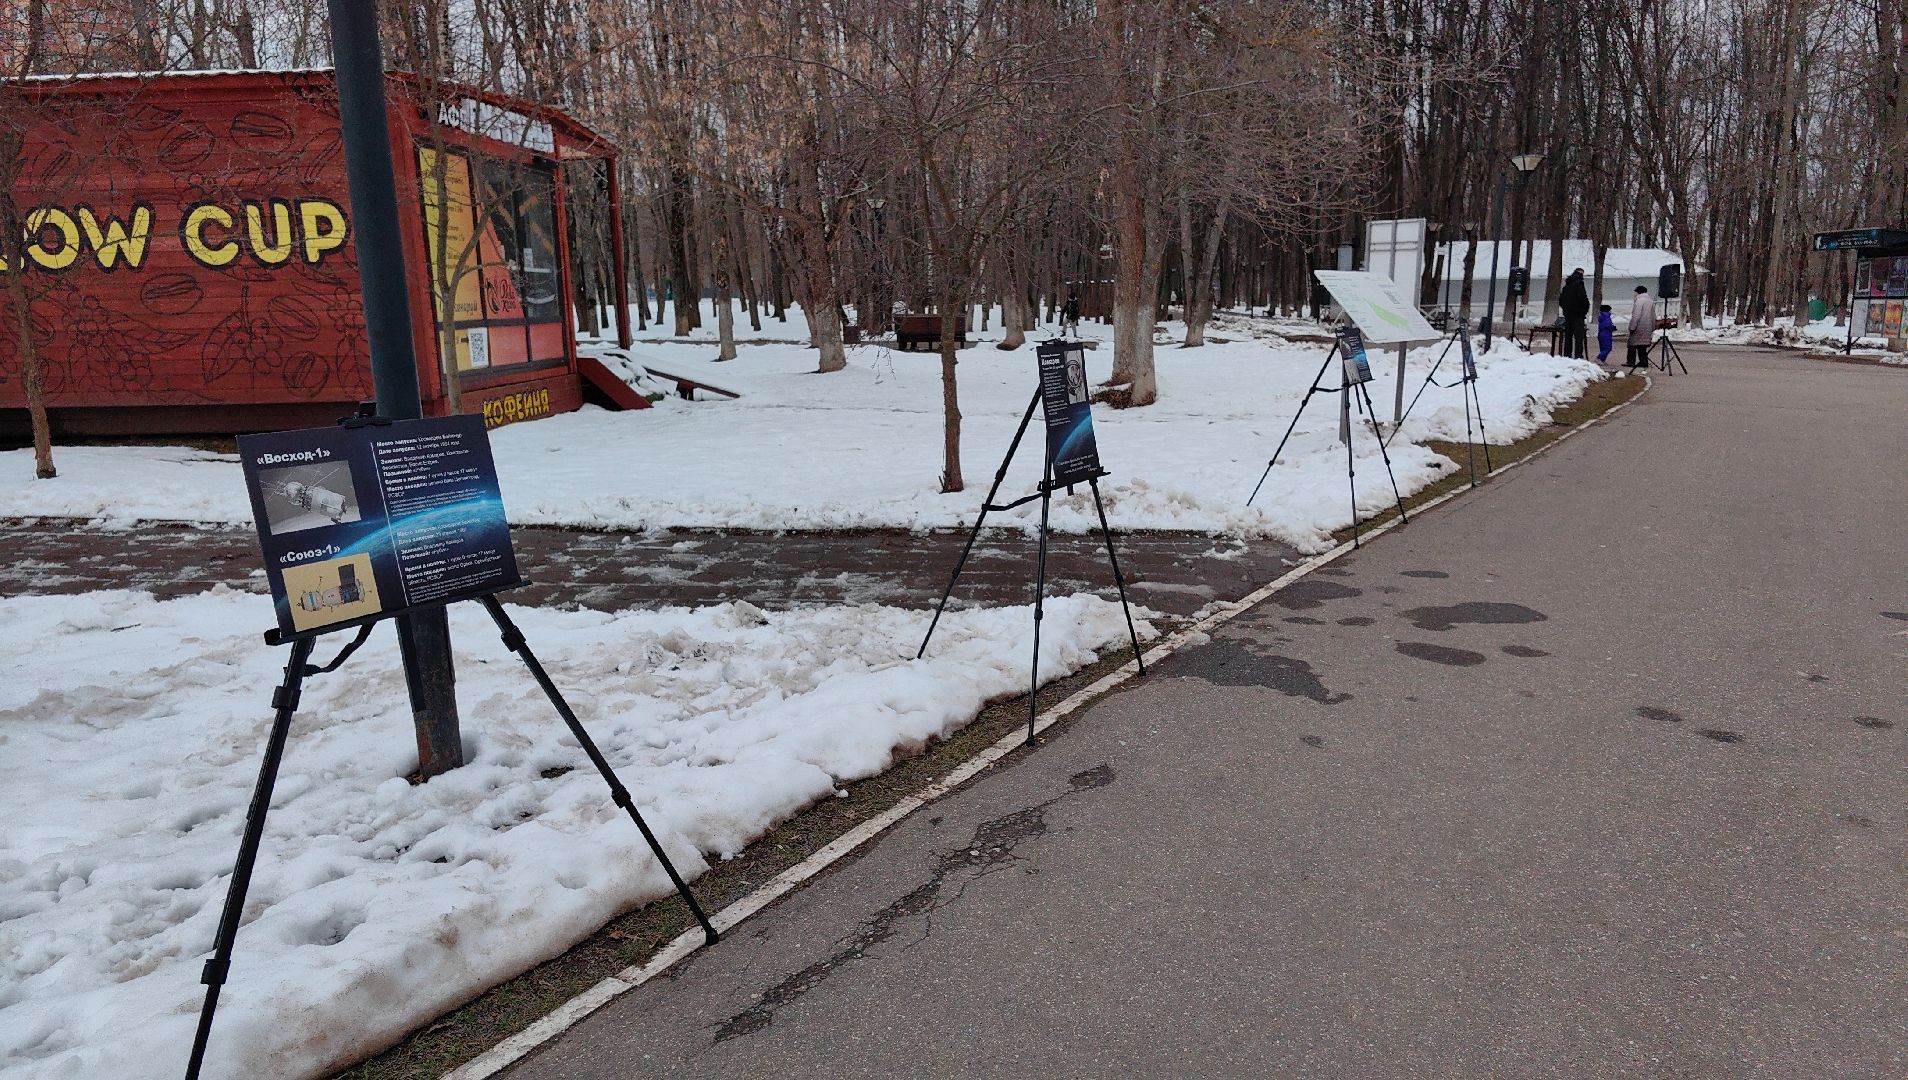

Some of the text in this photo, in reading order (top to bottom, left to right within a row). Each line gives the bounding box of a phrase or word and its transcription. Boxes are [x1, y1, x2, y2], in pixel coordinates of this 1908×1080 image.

[0, 199, 348, 271] OW CUP
[256, 447, 331, 465] «Восход-1»
[279, 543, 341, 563] «Союз-1»
